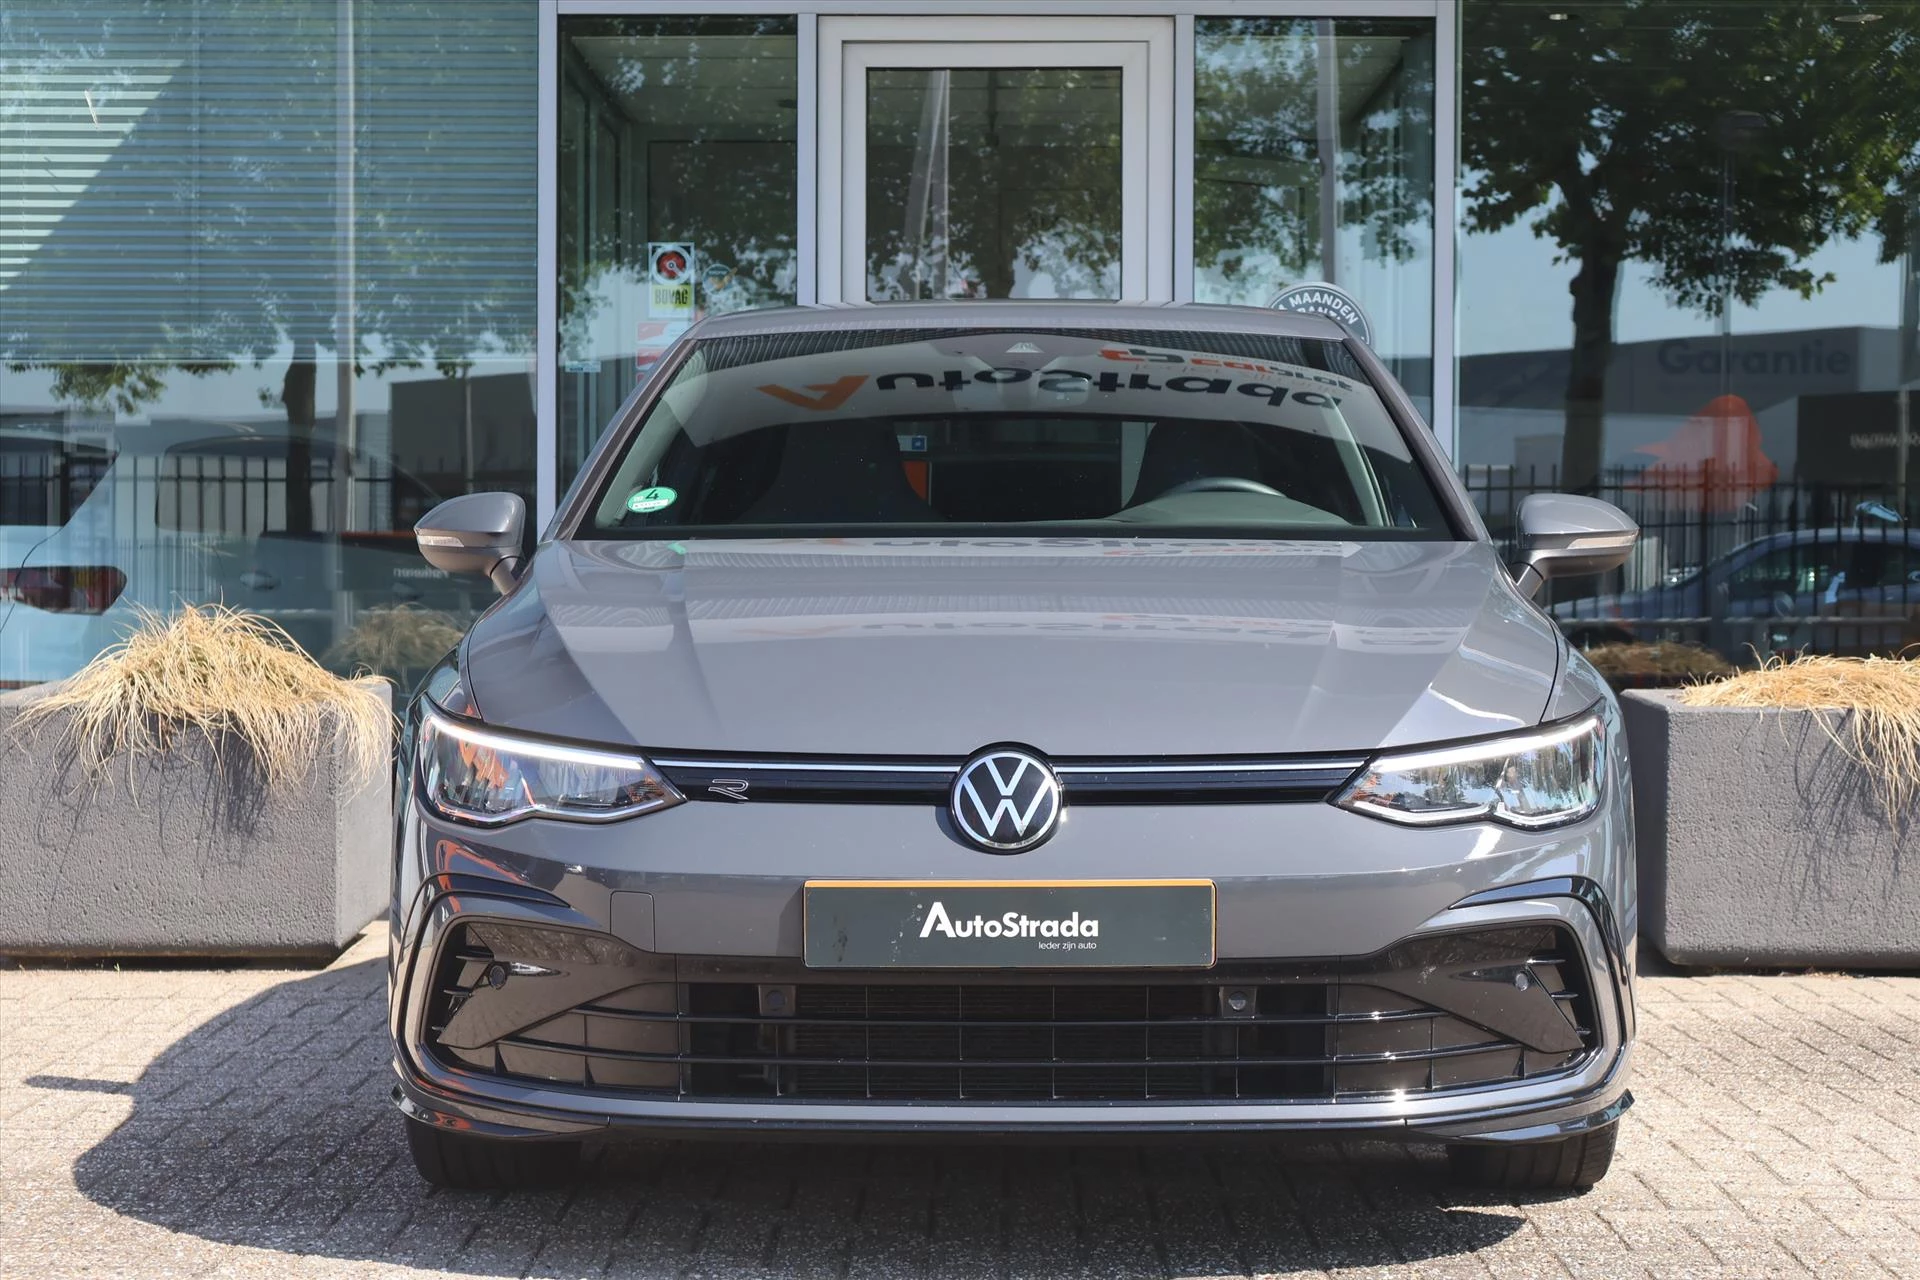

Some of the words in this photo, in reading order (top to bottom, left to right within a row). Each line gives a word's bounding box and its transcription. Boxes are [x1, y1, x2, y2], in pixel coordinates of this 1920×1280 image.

[655, 289, 688, 305] BOVAG
[1288, 291, 1359, 325] MAANDEN
[1656, 339, 1851, 376] Garantie
[645, 488, 660, 500] 4
[919, 901, 1099, 938] AutoStrada
[1038, 941, 1060, 950] Ieder
[1062, 941, 1076, 952] zijn
[1078, 942, 1097, 950] auto
